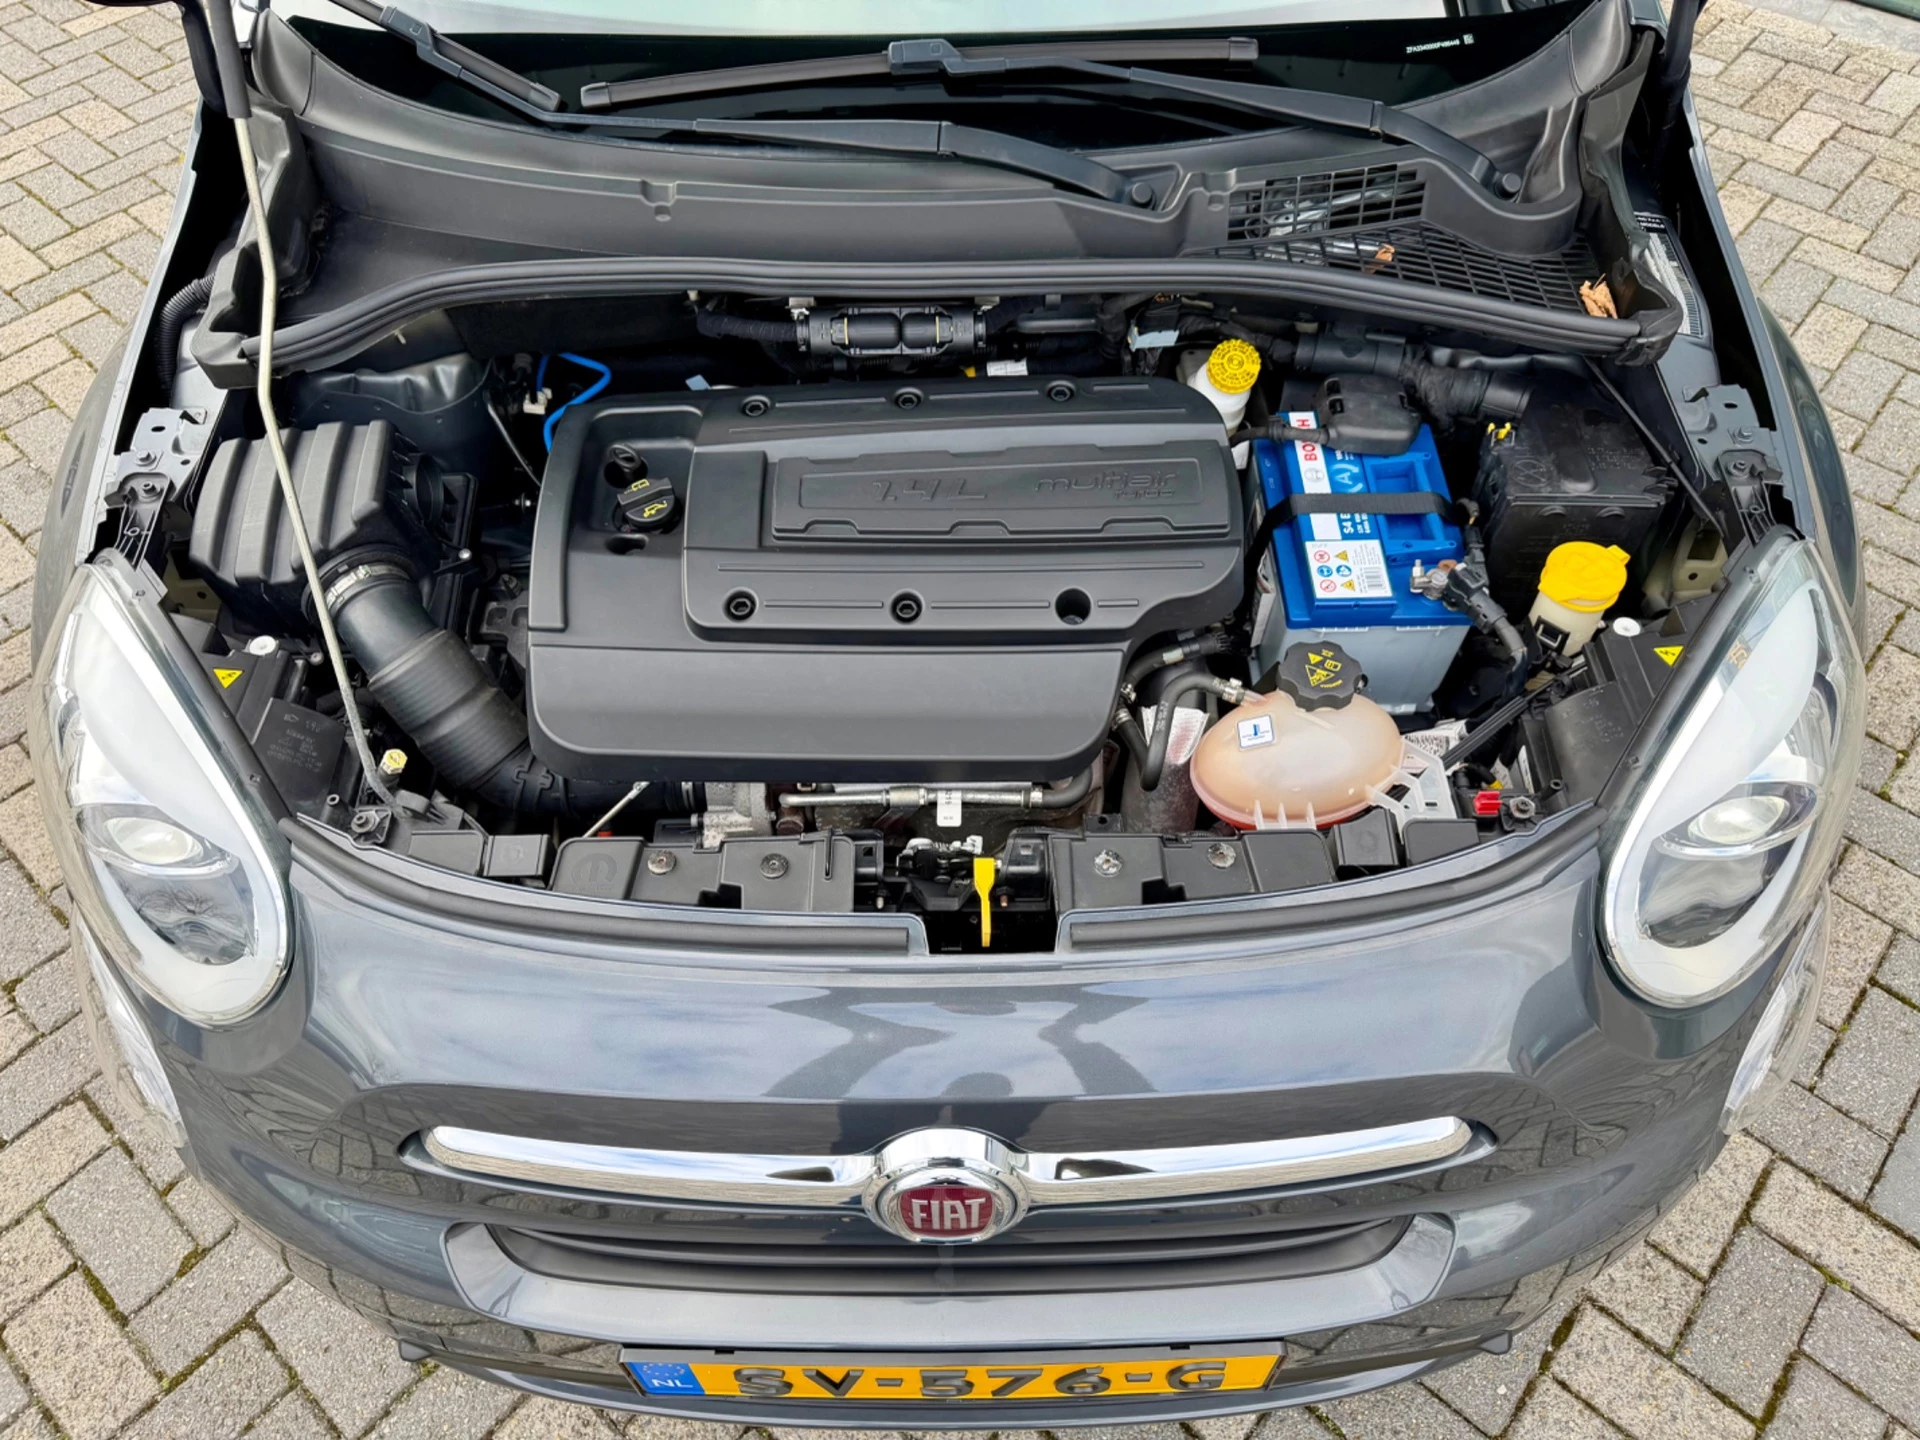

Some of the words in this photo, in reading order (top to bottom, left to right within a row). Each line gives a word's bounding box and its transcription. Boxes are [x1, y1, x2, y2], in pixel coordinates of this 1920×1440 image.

[1296, 418, 1318, 461] BOH
[911, 1198, 986, 1230] FIAT
[652, 1379, 694, 1389] NL
[733, 1361, 1227, 1398] SV-576-G
